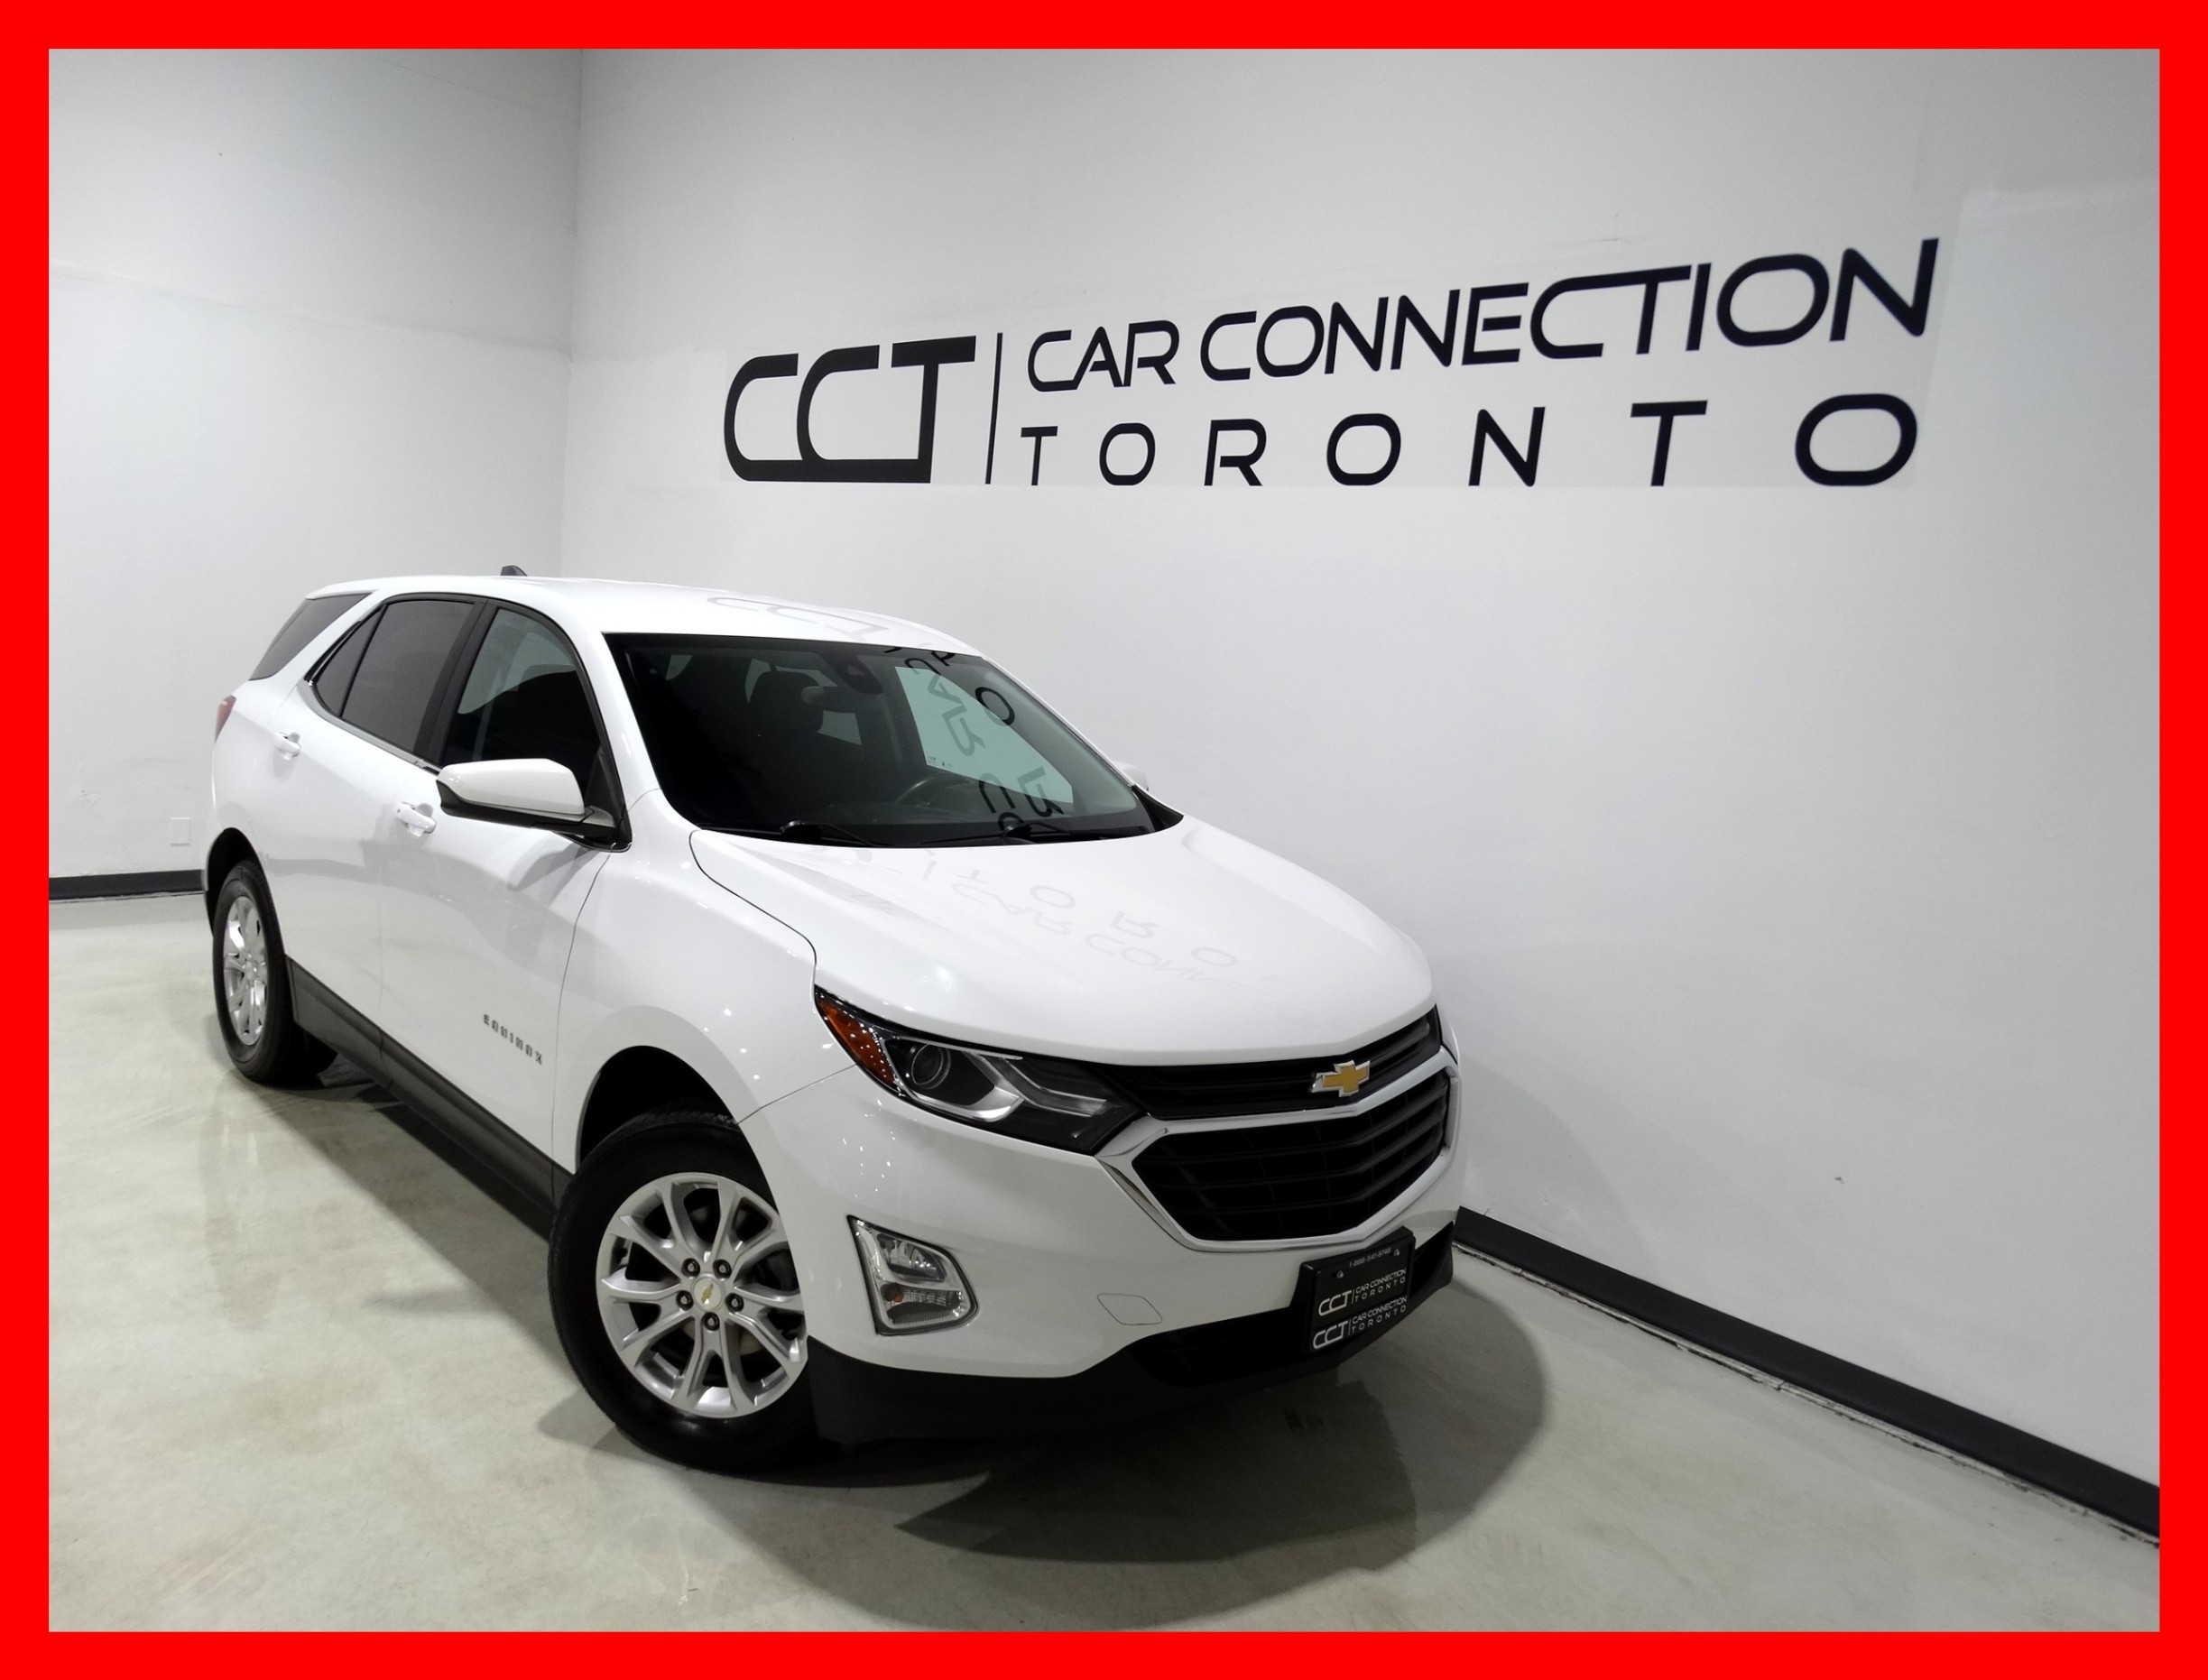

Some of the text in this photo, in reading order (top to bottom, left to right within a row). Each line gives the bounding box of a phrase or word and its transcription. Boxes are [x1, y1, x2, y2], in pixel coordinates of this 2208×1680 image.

[1027, 237, 1939, 392] CAR CONNECTION
[724, 335, 977, 484] CCT
[1021, 392, 1917, 487] TORONTO
[1354, 1276, 1406, 1303] TORONTO
[1355, 1268, 1407, 1295] CAR CONNECTION
[1318, 1289, 1352, 1316] CCT
[1352, 1296, 1408, 1325] CAR CONNECTION
[1351, 1305, 1407, 1334] TORONTO
[1313, 1320, 1348, 1350] CCT
